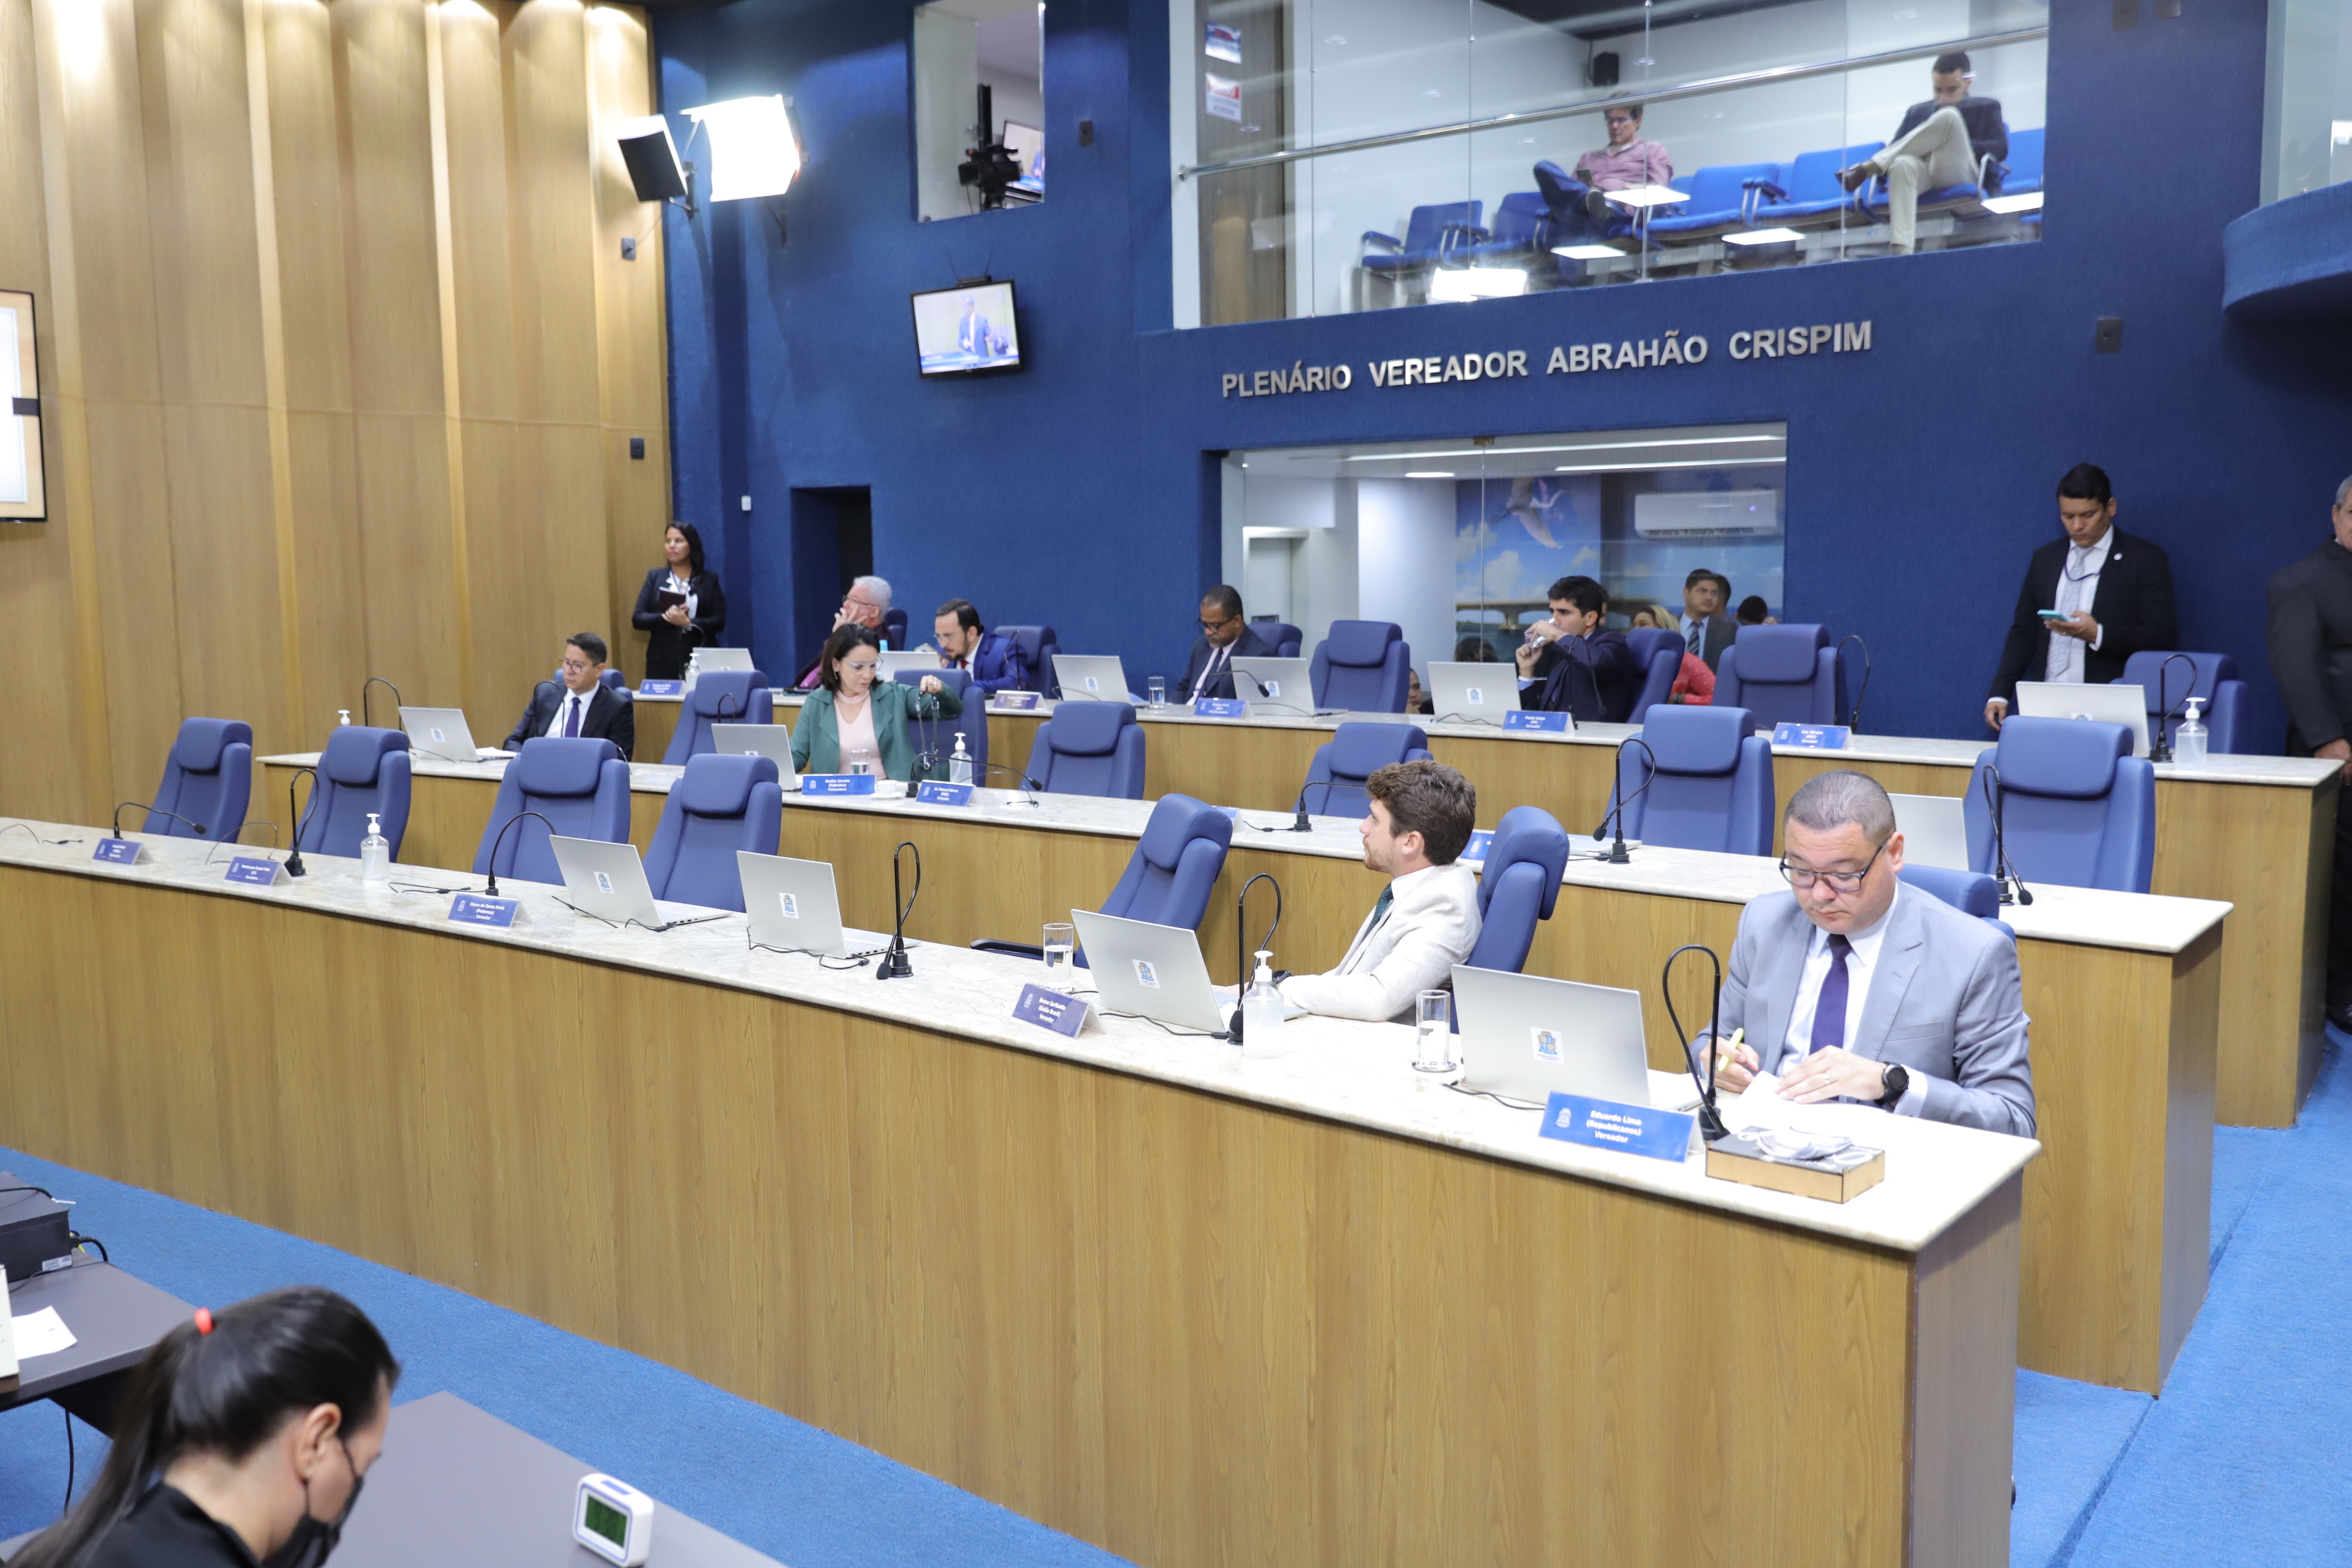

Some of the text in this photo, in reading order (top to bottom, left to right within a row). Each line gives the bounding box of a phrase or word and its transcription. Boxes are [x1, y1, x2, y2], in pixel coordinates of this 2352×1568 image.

[1222, 320, 1872, 399] PLENÁRIO VEREADOR ABRAHÃO CRISPIM
[1590, 1110, 1643, 1126] Eduardo Lima
[1586, 1119, 1643, 1137] (Republicanos)
[1594, 1129, 1629, 1143] Vereador
